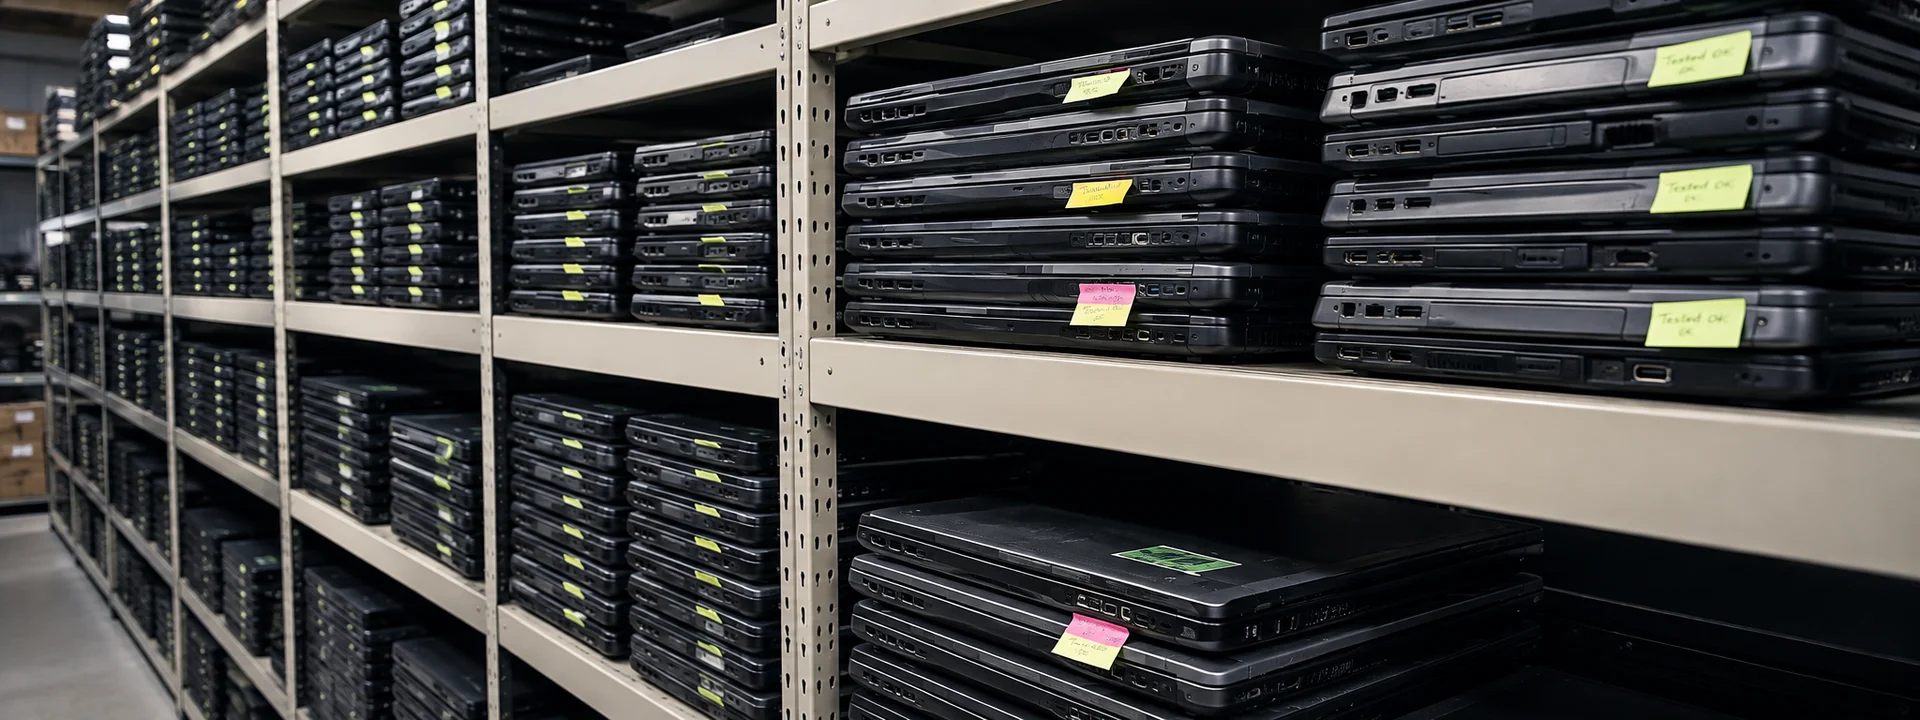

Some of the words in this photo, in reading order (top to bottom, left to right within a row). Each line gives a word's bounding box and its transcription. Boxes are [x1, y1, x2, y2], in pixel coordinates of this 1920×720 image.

[1662, 48, 1707, 66] Tested
[1666, 180, 1709, 193] Tested
[1658, 312, 1702, 325] Tested
